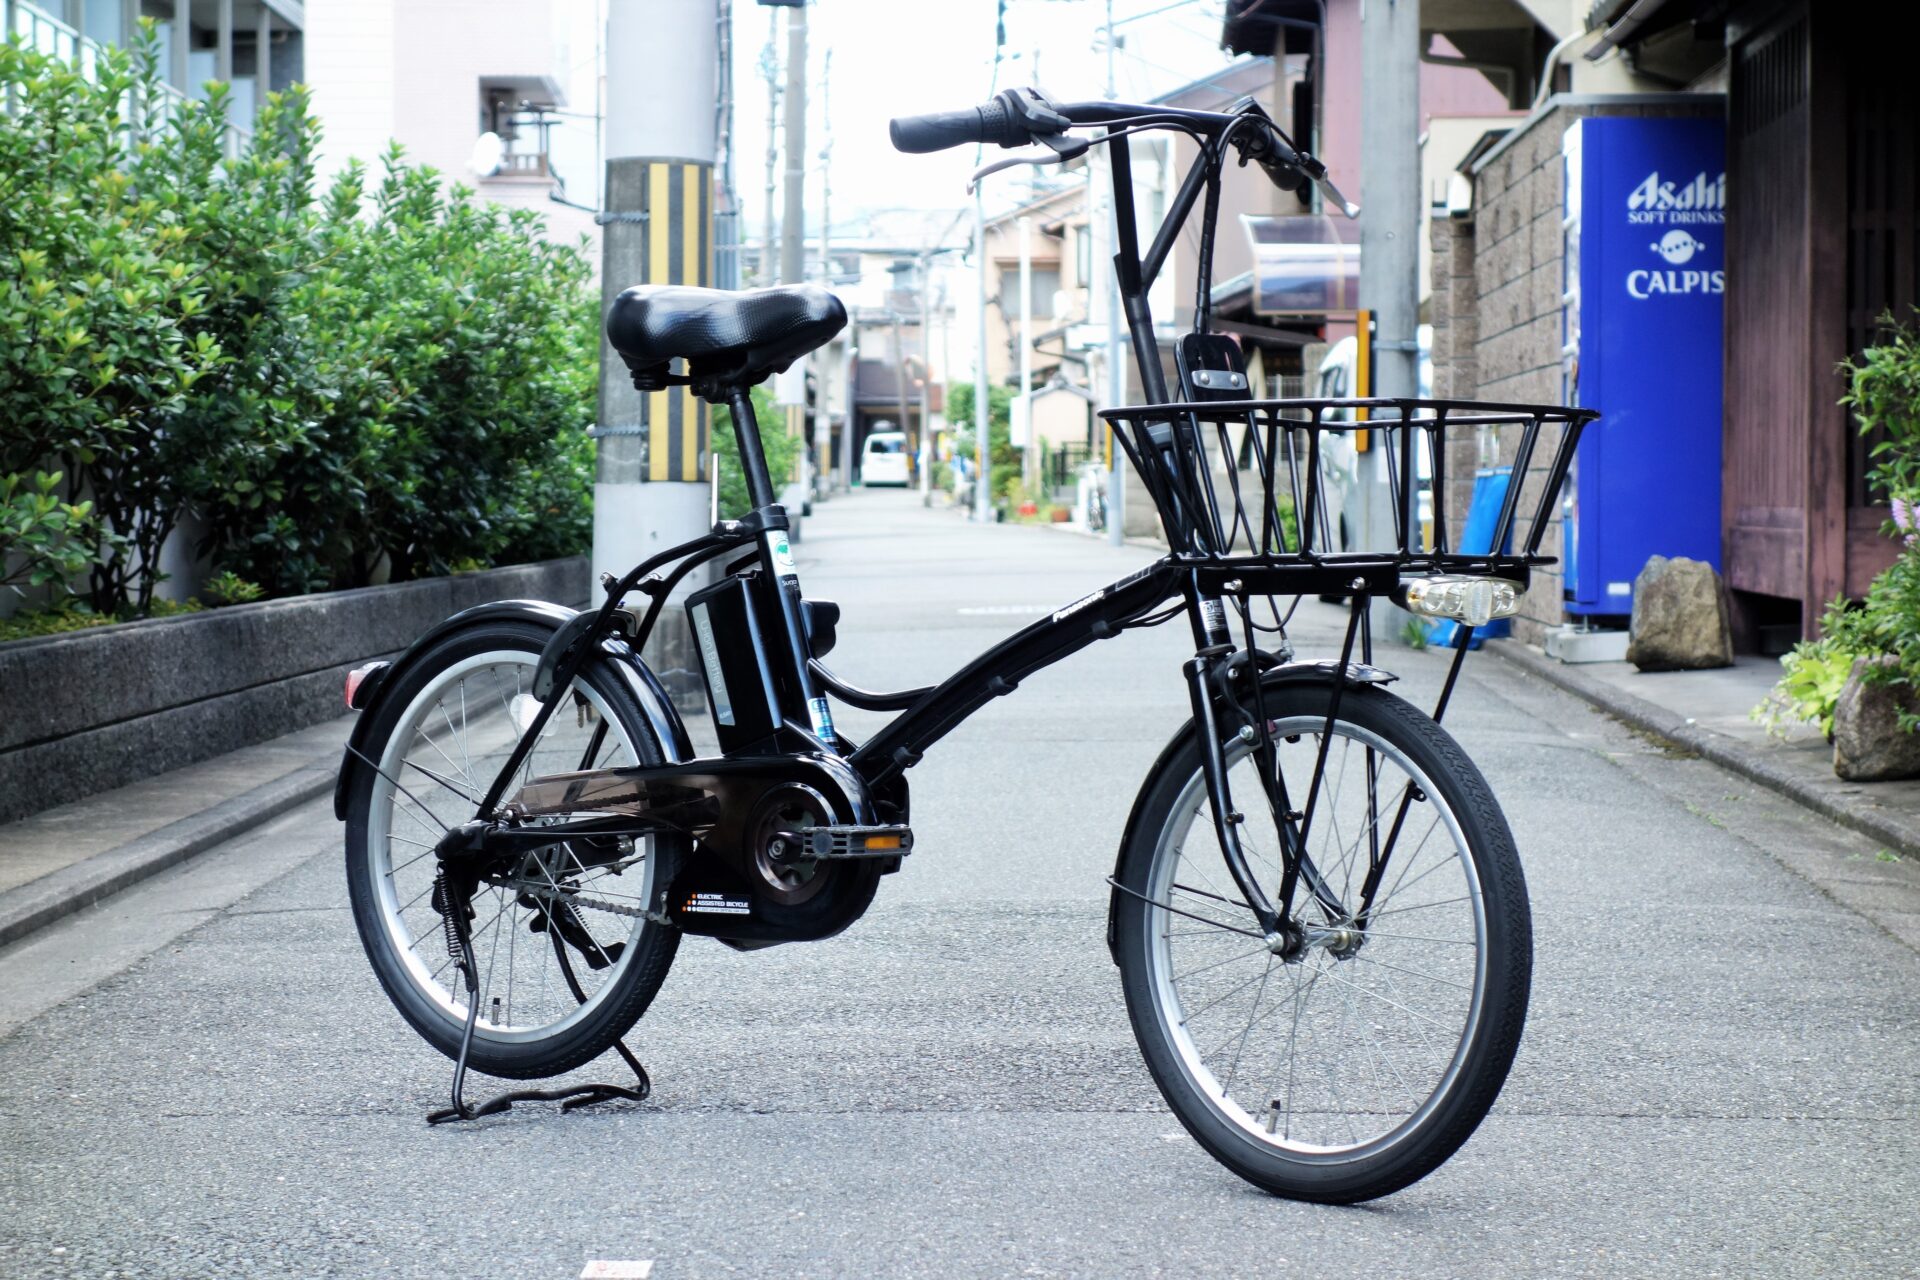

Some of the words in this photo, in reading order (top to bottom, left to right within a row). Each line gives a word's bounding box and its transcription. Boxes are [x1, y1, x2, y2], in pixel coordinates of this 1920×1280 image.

[1627, 171, 1726, 210] Asahi
[1628, 211, 1667, 224] SOFT
[1669, 211, 1726, 224] DRINKS
[1627, 269, 1725, 299] CALPIS
[707, 651, 722, 694] Battery
